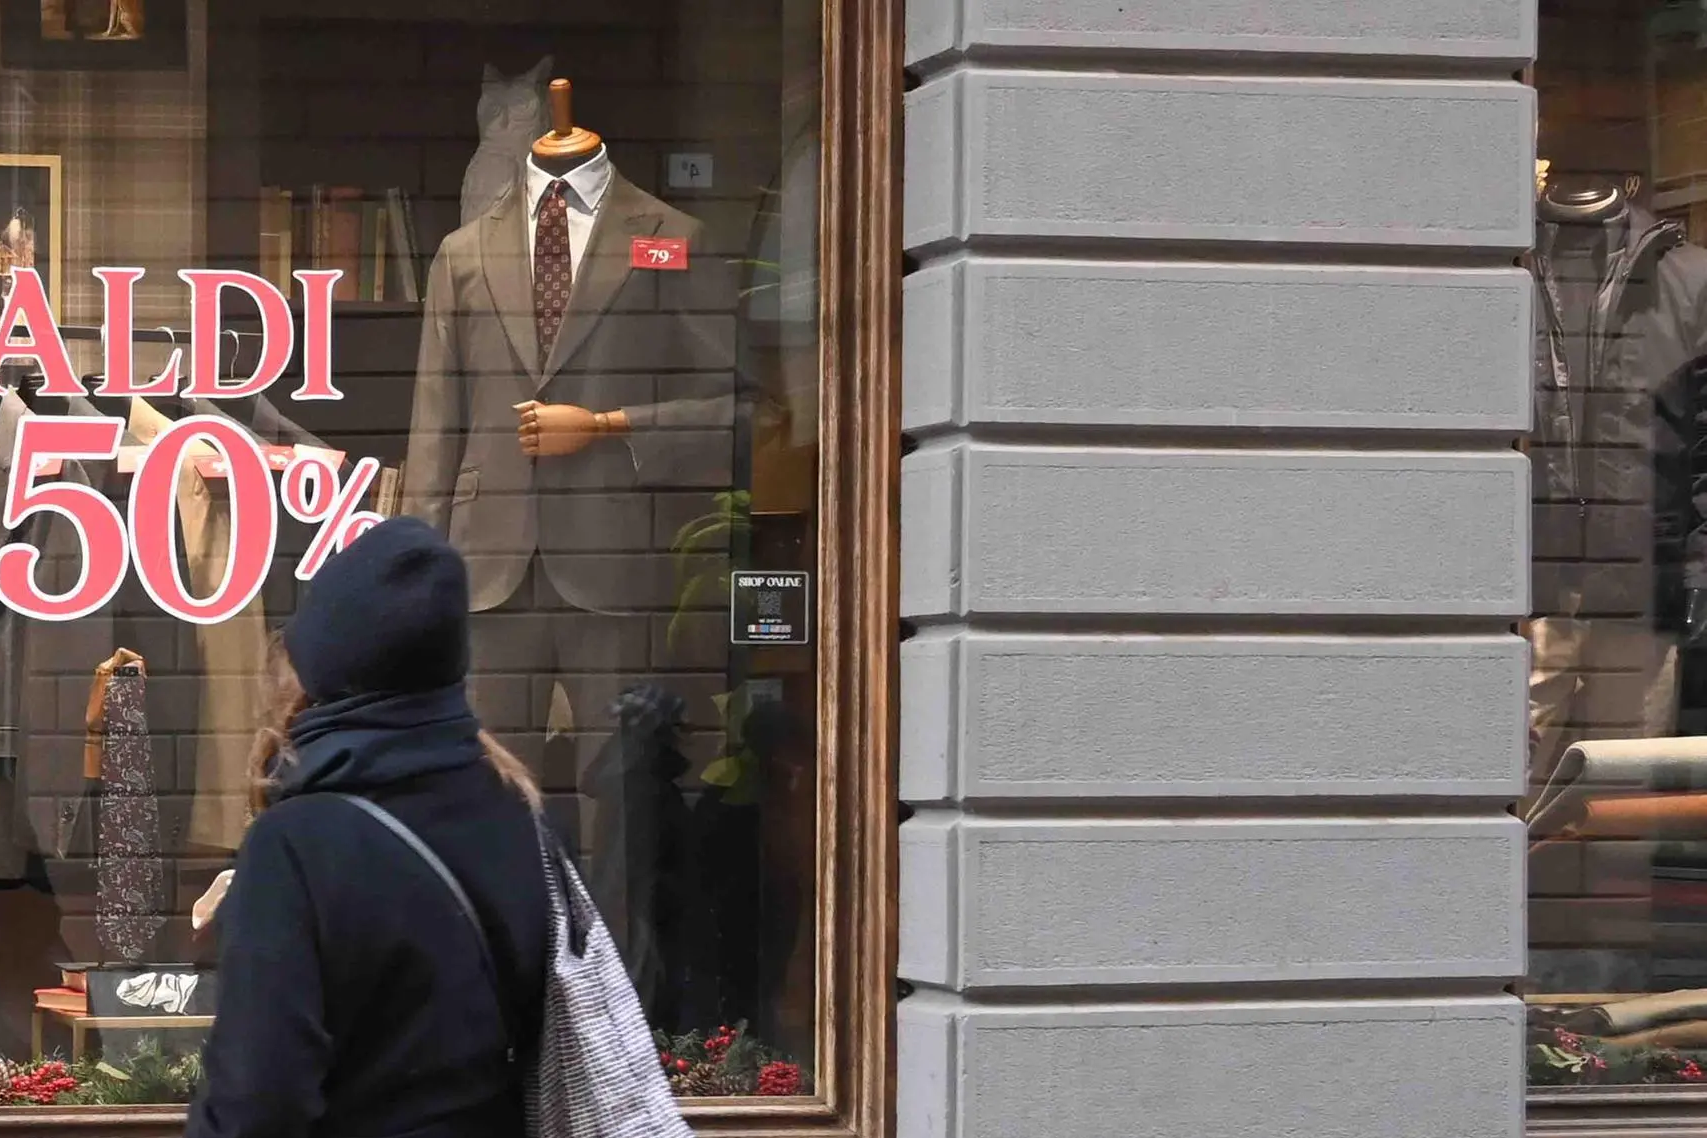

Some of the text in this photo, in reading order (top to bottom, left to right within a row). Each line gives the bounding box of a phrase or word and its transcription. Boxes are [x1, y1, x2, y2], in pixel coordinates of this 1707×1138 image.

[648, 249, 670, 264] 79
[738, 577, 803, 587] SHOP ONLINE
